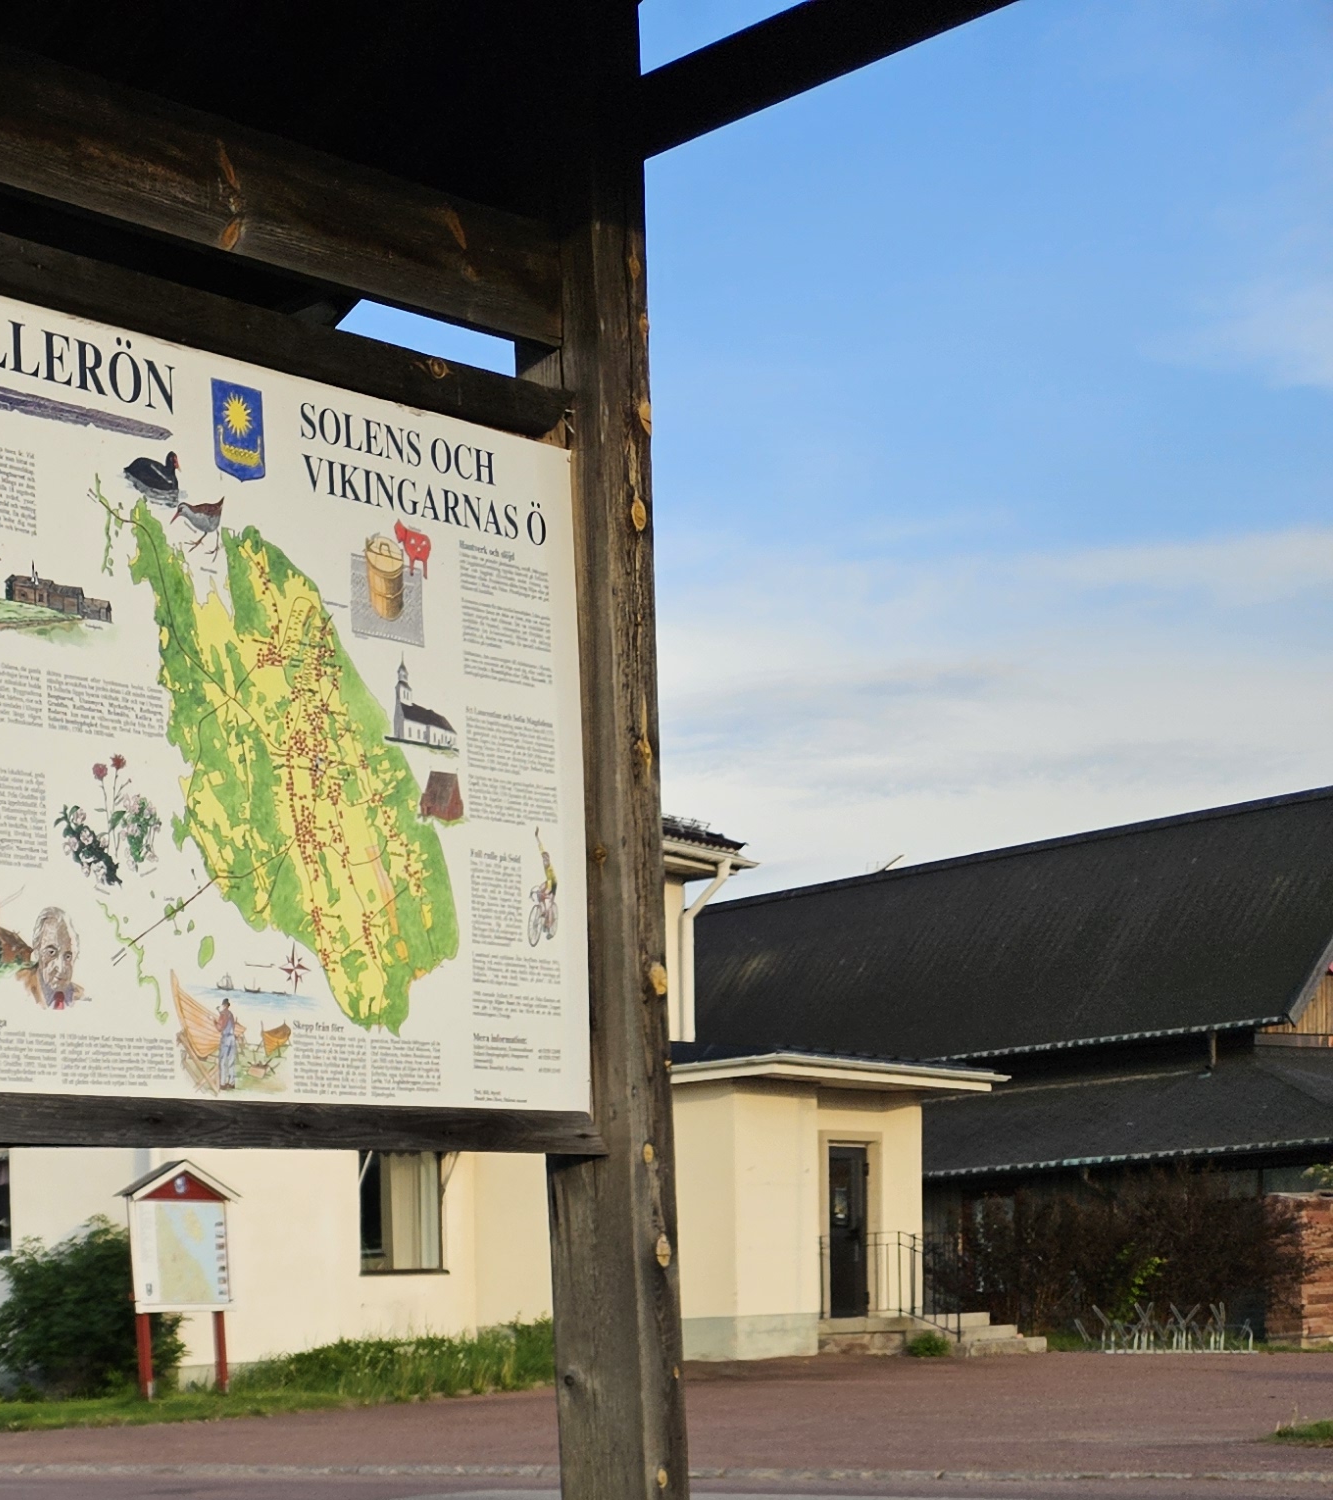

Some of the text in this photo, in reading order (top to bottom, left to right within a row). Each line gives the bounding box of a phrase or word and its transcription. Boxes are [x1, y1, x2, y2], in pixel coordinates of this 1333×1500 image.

[300, 402, 496, 486] SOLENS OCH
[301, 453, 546, 545] VIKINGARNAS Ö
[489, 548, 499, 557] och
[292, 1019, 314, 1036] Skepp
[316, 1021, 330, 1033] från
